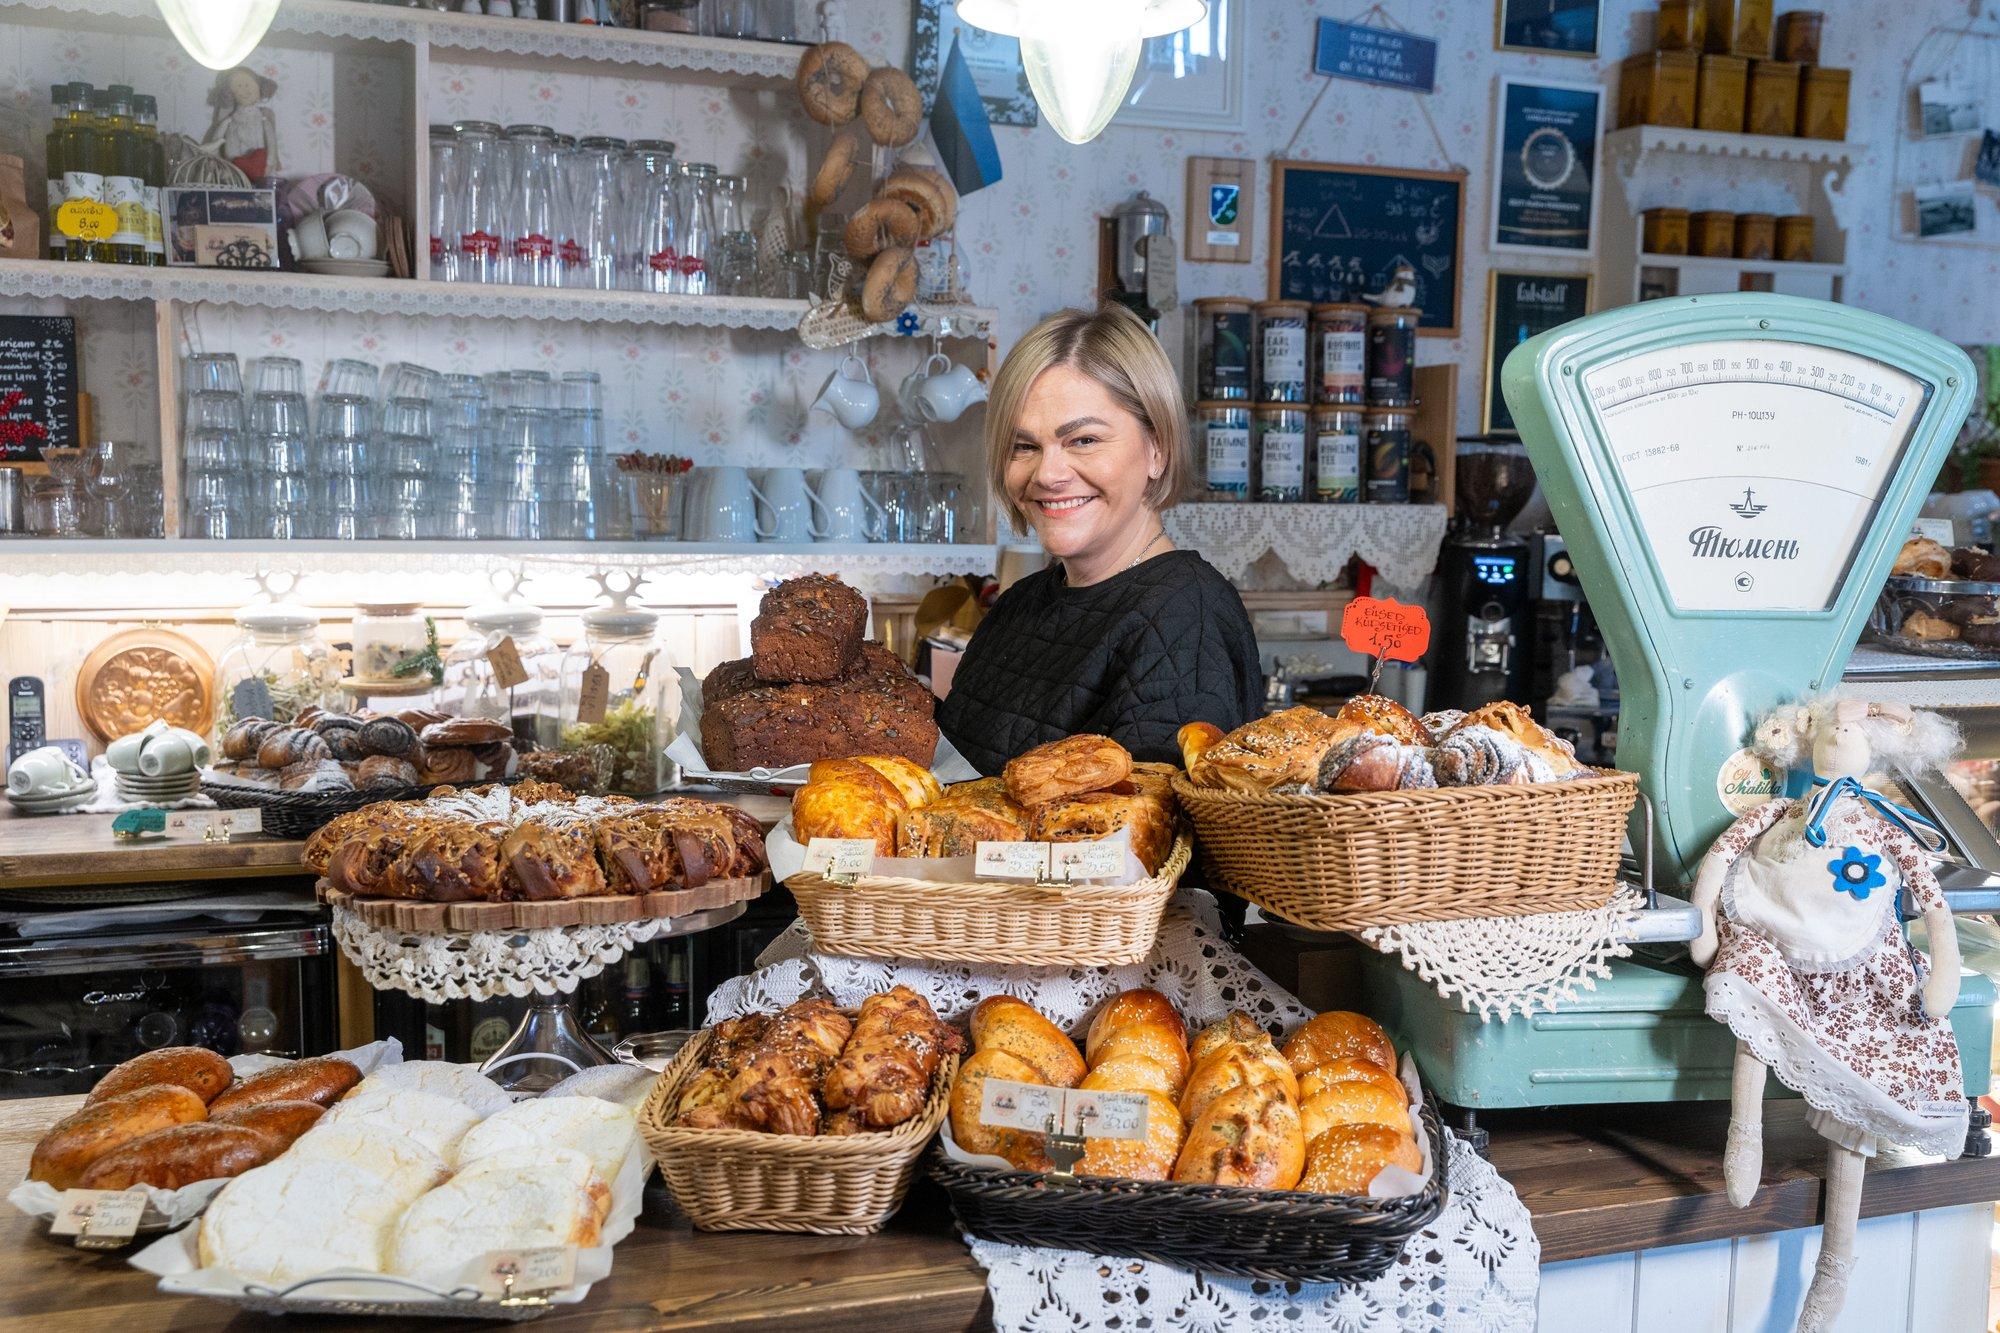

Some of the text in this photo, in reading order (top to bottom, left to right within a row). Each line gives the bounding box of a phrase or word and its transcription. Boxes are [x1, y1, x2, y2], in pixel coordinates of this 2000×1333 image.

[1267, 336, 1289, 346] EARL
[1327, 352, 1342, 361] TEE
[1618, 376, 1633, 390] 900
[1635, 375, 1645, 384] 850
[1648, 368, 1662, 380] 800
[1666, 369, 1677, 378] 750
[1680, 362, 1694, 374] 700
[1697, 363, 1709, 372] 650
[1712, 359, 1726, 370] 600
[1731, 361, 1741, 370] 550
[1746, 358, 1759, 370] 500
[1764, 362, 1774, 371] 450
[1779, 360, 1792, 372] 400
[1797, 366, 1807, 375] 350
[1810, 366, 1825, 378] 300
[1828, 373, 1838, 382] 250
[1840, 373, 1856, 387] 200
[1857, 382, 1866, 391] 150
[1870, 383, 1882, 397] 100
[1898, 396, 1905, 408] 0
[1210, 449, 1225, 459] TEE
[1622, 451, 1641, 463] ГОСТ
[1320, 456, 1335, 465] TEE
[1689, 525, 1800, 560] Тюмень
[1368, 633, 1402, 650] 1.50
[1724, 780, 1783, 795] Matilda
